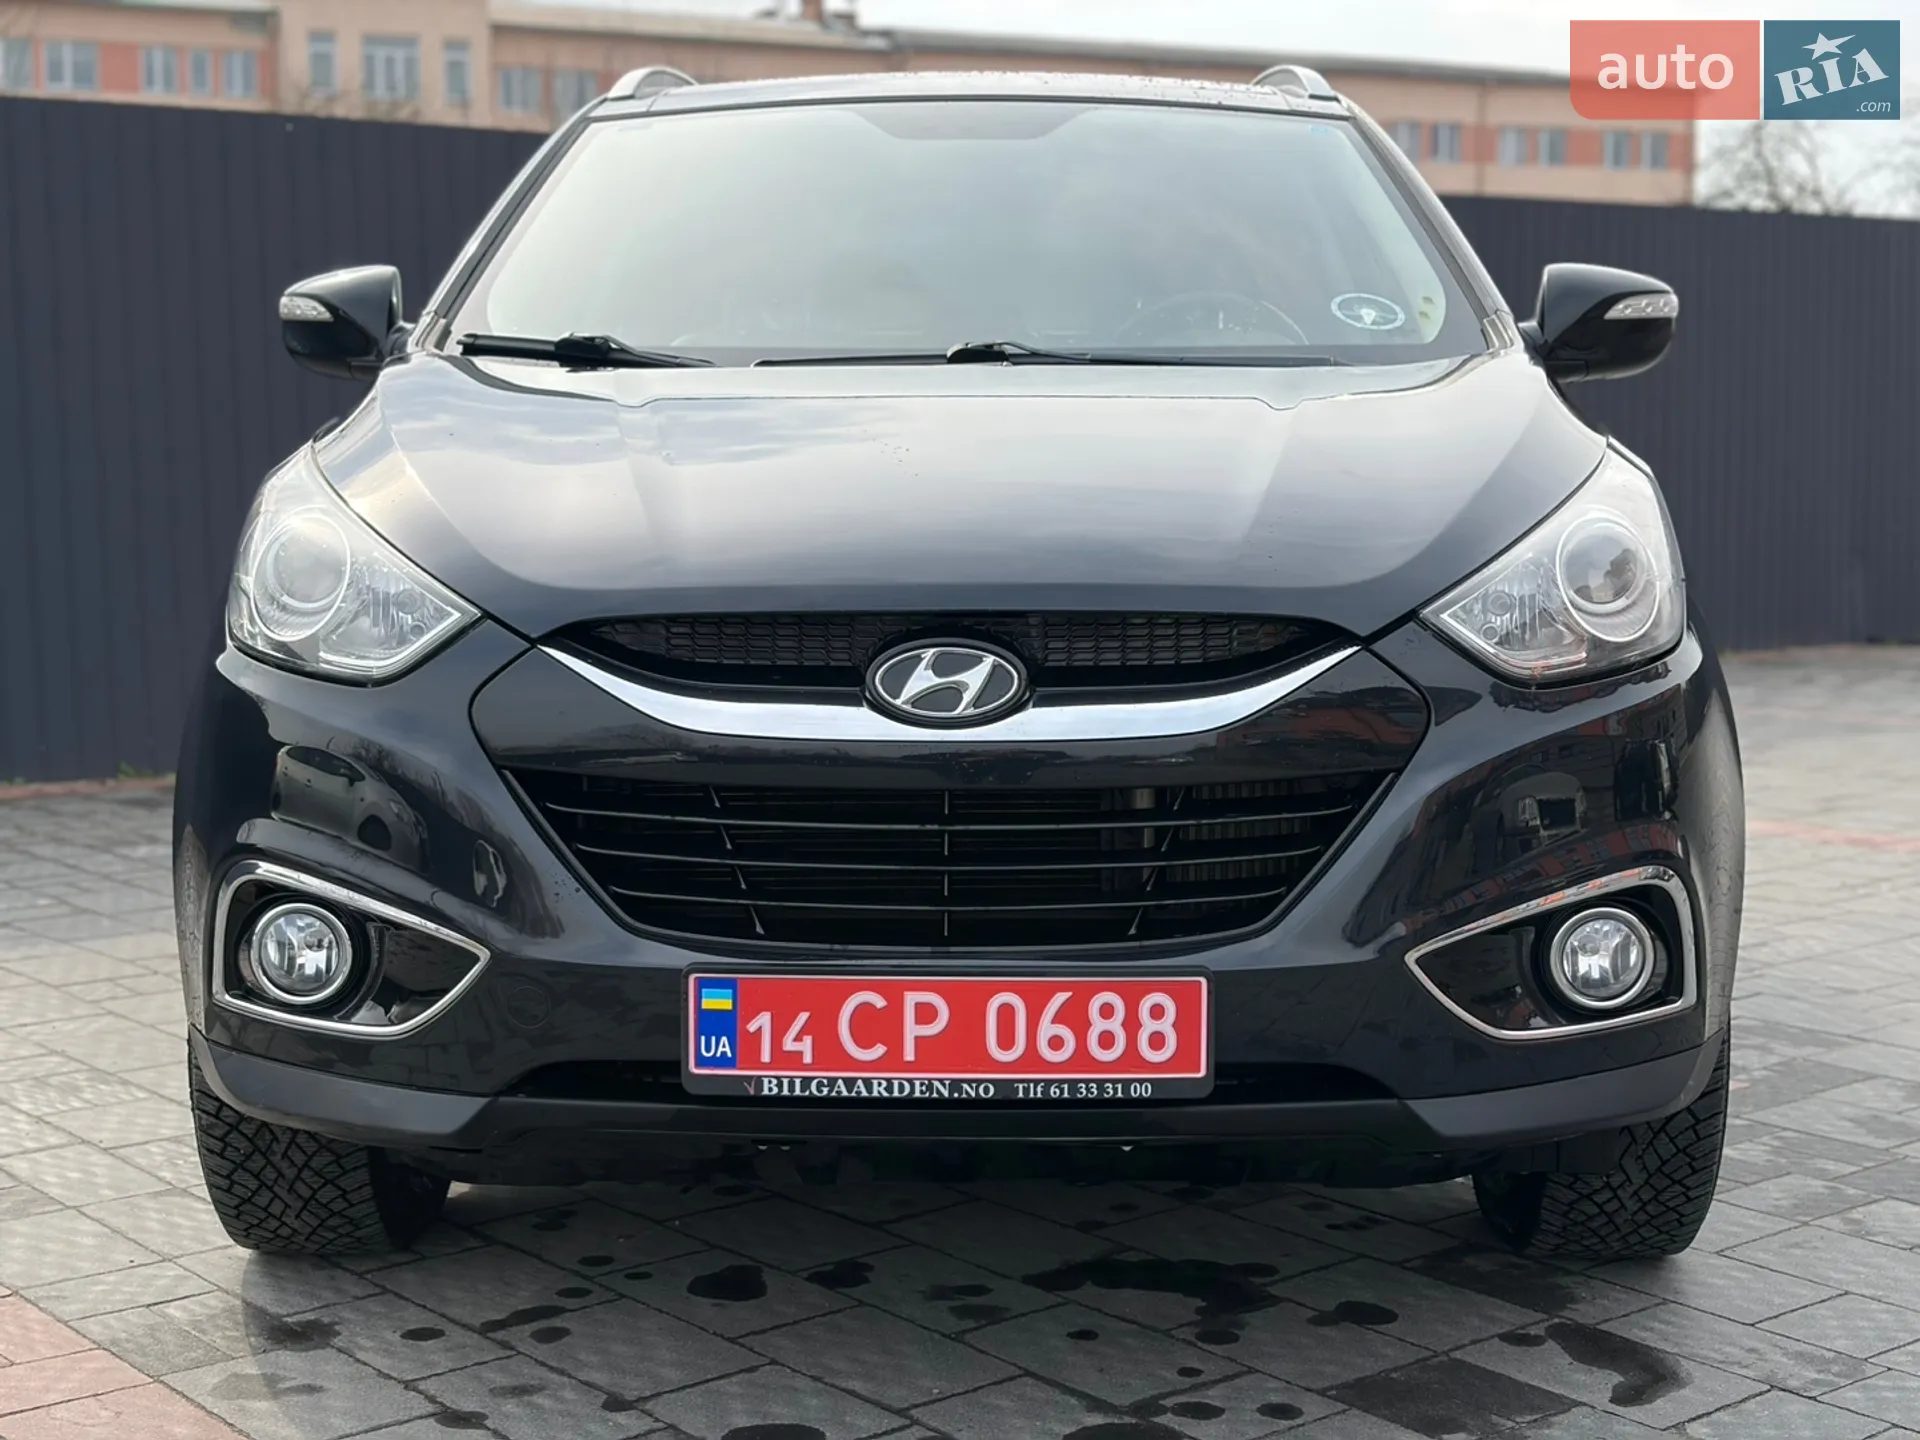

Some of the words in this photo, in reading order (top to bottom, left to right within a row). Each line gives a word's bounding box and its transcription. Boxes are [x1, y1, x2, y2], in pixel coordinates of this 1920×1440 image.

[746, 1011, 813, 1064] 14
[837, 990, 950, 1062] CP
[985, 991, 1178, 1063] 0688
[701, 1035, 732, 1058] UA
[761, 1076, 995, 1098] BILGAARDEN.NO
[1014, 1083, 1044, 1097] Tlf
[1050, 1082, 1068, 1098] 61
[1077, 1082, 1098, 1098] 33
[1103, 1082, 1124, 1098] 31
[1130, 1082, 1152, 1098] 00
